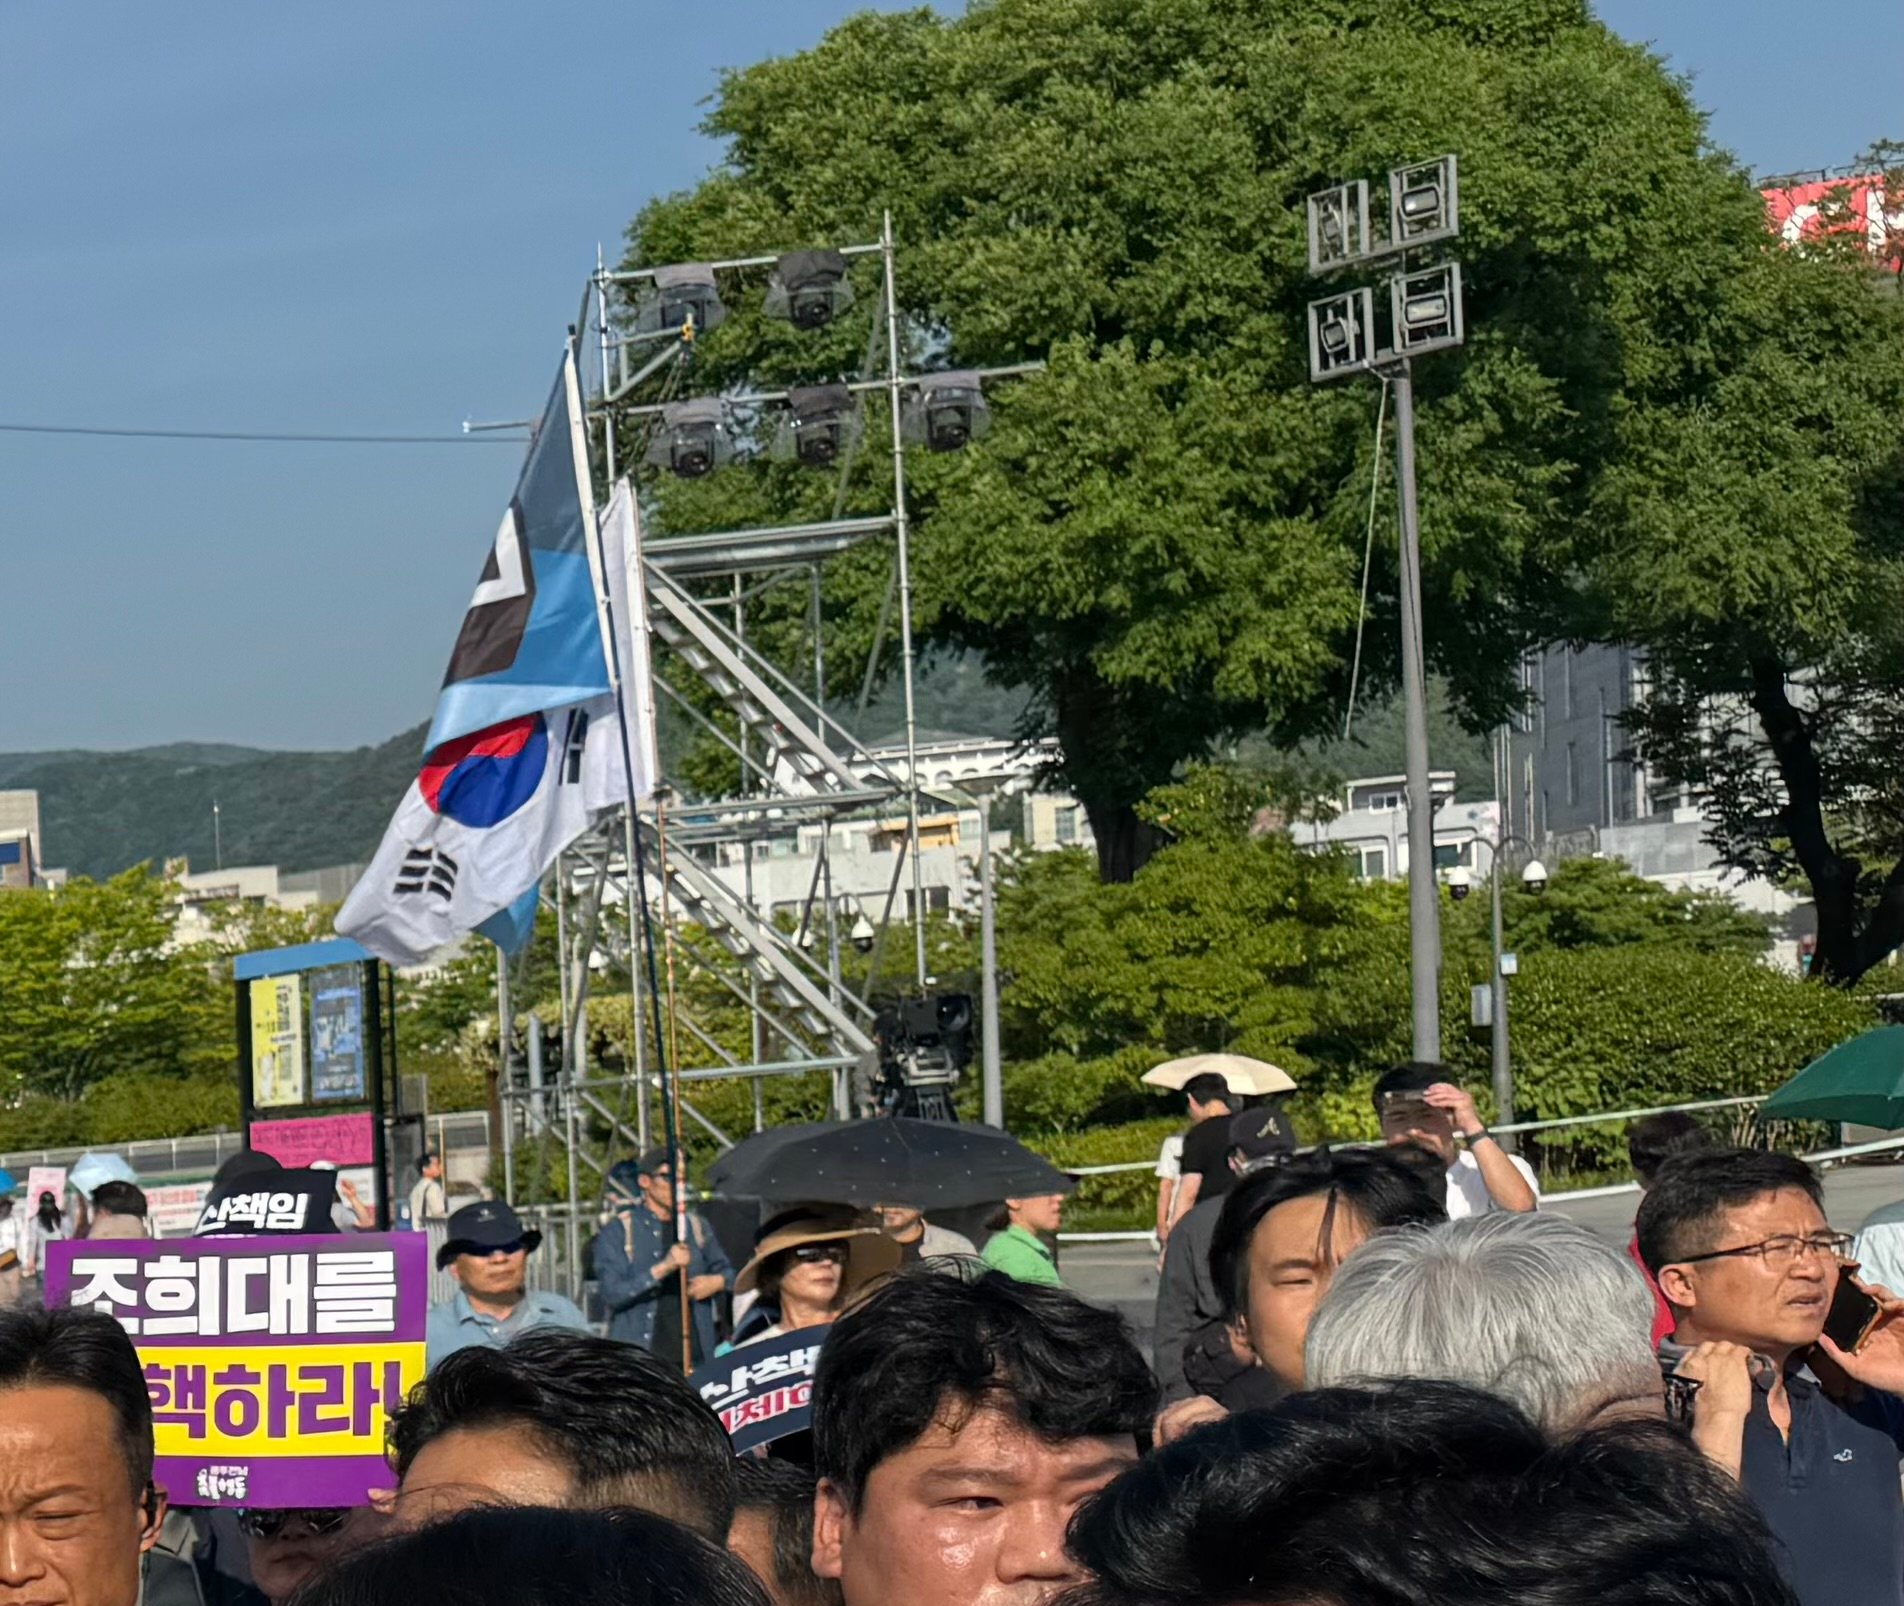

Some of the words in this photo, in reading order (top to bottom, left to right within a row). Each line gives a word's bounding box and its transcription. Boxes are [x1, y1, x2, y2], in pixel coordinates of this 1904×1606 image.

[70, 1250, 397, 1336] 조희대를
[145, 1360, 402, 1440] 핵하라!
[699, 1344, 822, 1412] 산책
